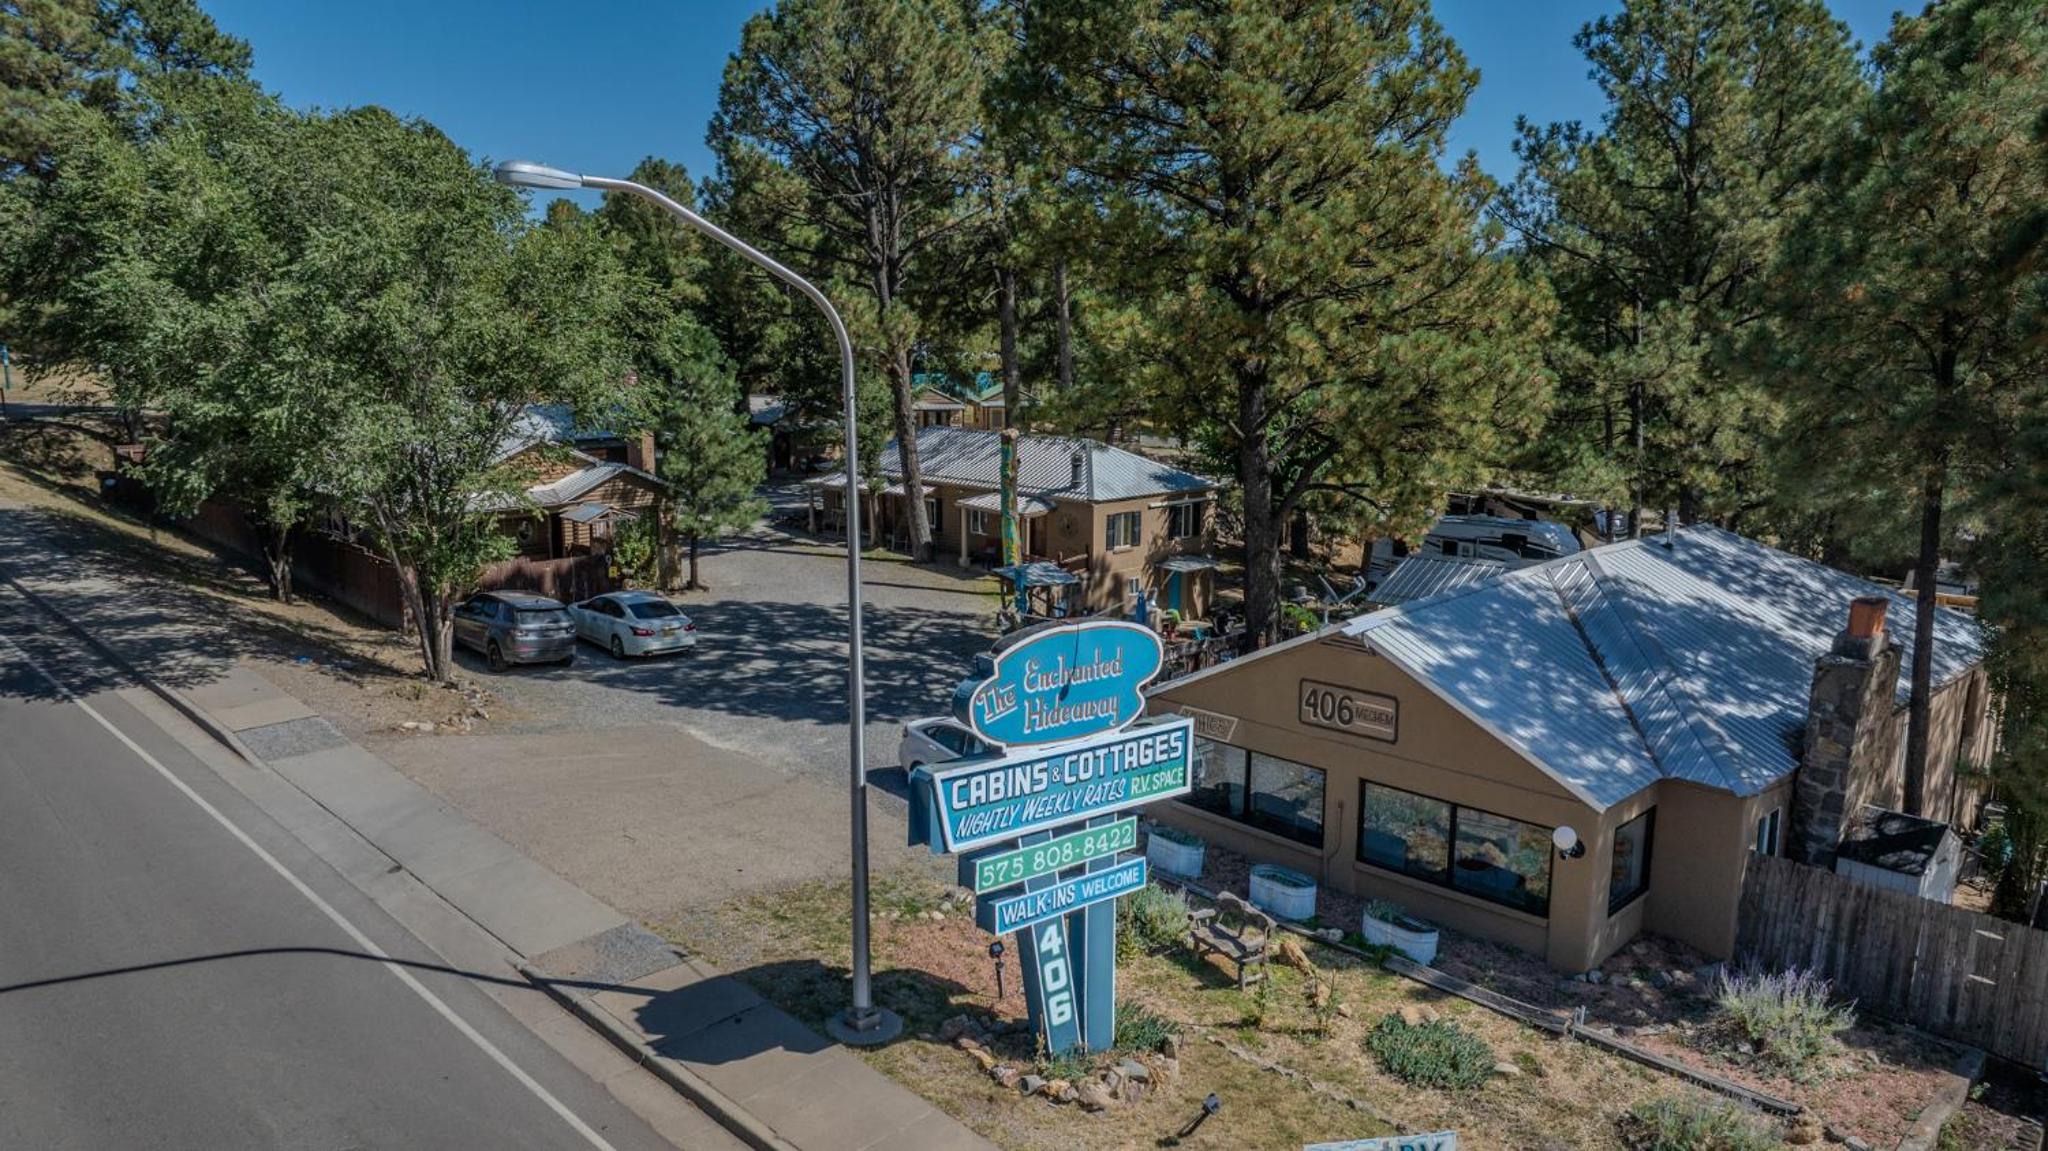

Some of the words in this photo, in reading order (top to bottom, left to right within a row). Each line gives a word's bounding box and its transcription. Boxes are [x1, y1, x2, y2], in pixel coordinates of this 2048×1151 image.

[1023, 647, 1123, 694] Enchanted
[975, 687, 1017, 721] The
[1023, 693, 1119, 735] Hideaway
[1304, 687, 1354, 727] 406
[952, 760, 1049, 811] CABINS
[1052, 767, 1063, 783] &
[1064, 731, 1184, 785] COTTAGES
[1130, 775, 1150, 795] R.V.
[1152, 766, 1184, 791] SPACE
[955, 803, 1021, 839] NIGHTLY
[1021, 787, 1083, 822] WEEKLY
[1082, 778, 1126, 806] RATES
[981, 857, 1025, 887] 575
[1033, 824, 1132, 872] 808-8422
[1001, 884, 1077, 926] WALK-INS
[1082, 866, 1140, 899] WELCOME
[1039, 923, 1073, 1027] 406
